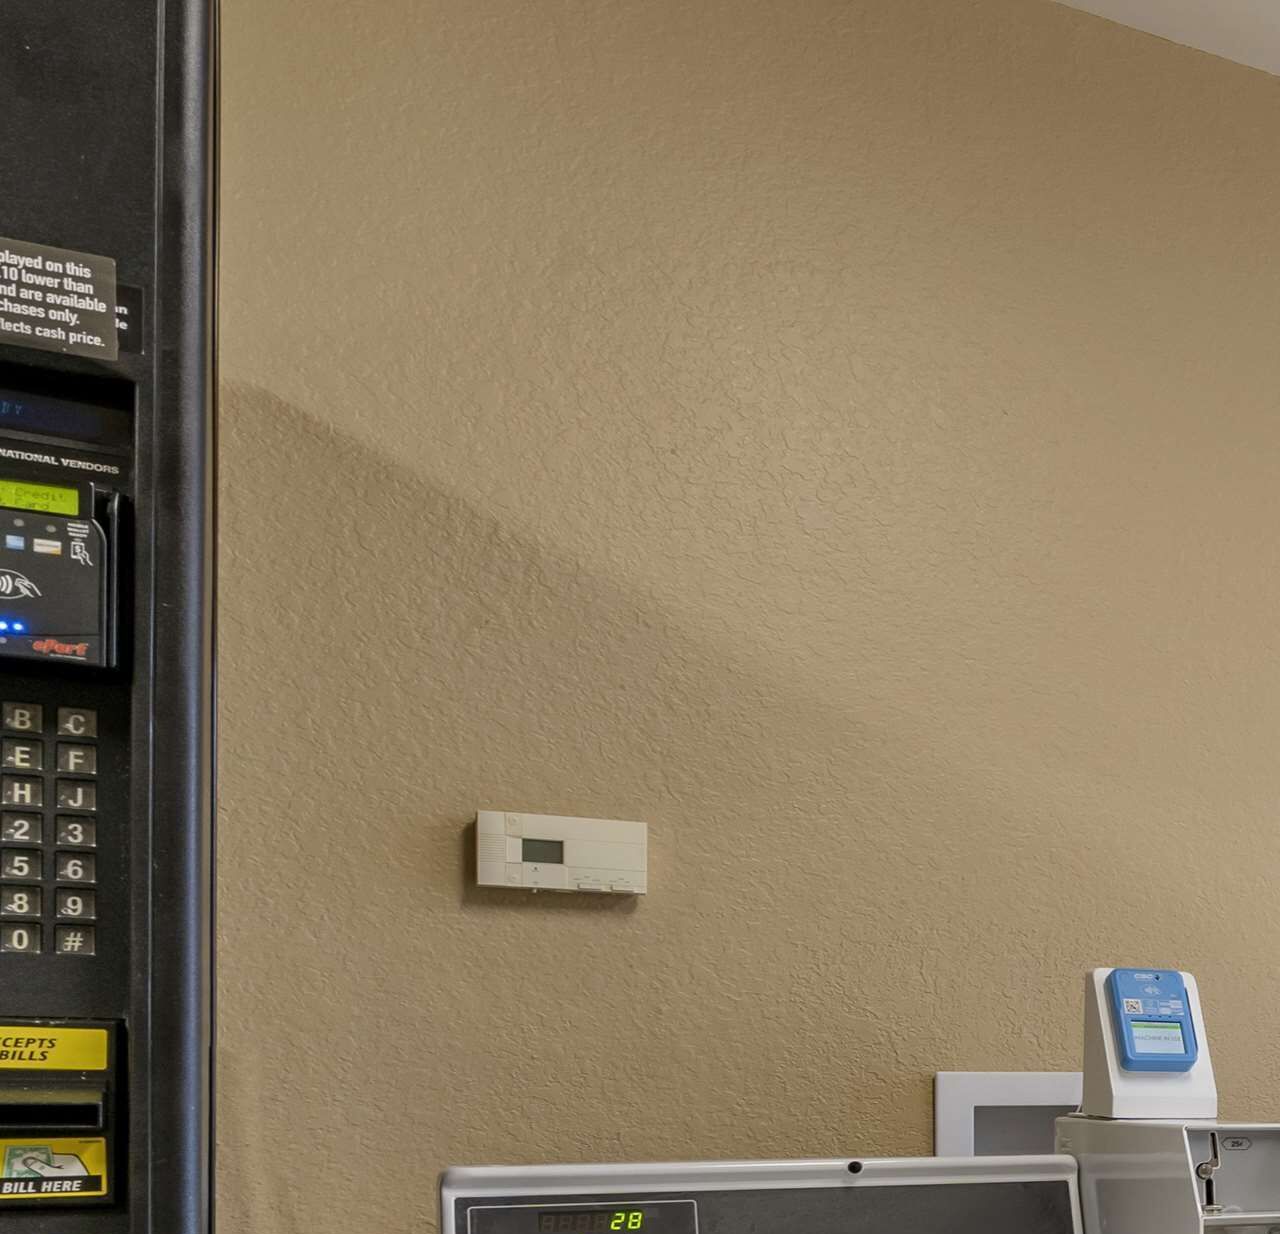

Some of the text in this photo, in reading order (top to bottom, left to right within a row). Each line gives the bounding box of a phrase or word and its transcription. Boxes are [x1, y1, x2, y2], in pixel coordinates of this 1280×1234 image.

[45, 261, 63, 273] on
[65, 262, 92, 279] this
[21, 269, 61, 289] lower
[63, 277, 94, 295] than
[20, 288, 43, 302] are
[46, 293, 107, 312] available
[48, 308, 80, 326] only.
[0, 317, 105, 347] lects cash price.
[60, 457, 120, 475] VENDORS
[14, 709, 31, 729] B
[68, 714, 85, 735] C
[14, 746, 31, 767] E
[68, 751, 84, 771] F
[13, 783, 31, 803] H
[68, 788, 83, 807] J
[13, 820, 30, 840] 2
[67, 823, 83, 843] 3
[13, 856, 29, 876] 5
[66, 859, 83, 879] 6
[13, 893, 29, 913] 8
[66, 896, 83, 916] 9
[12, 929, 29, 950] 0
[0, 1050, 48, 1061] BILLS
[2, 1180, 82, 1194] BILL HERE
[610, 1212, 643, 1230] 28
